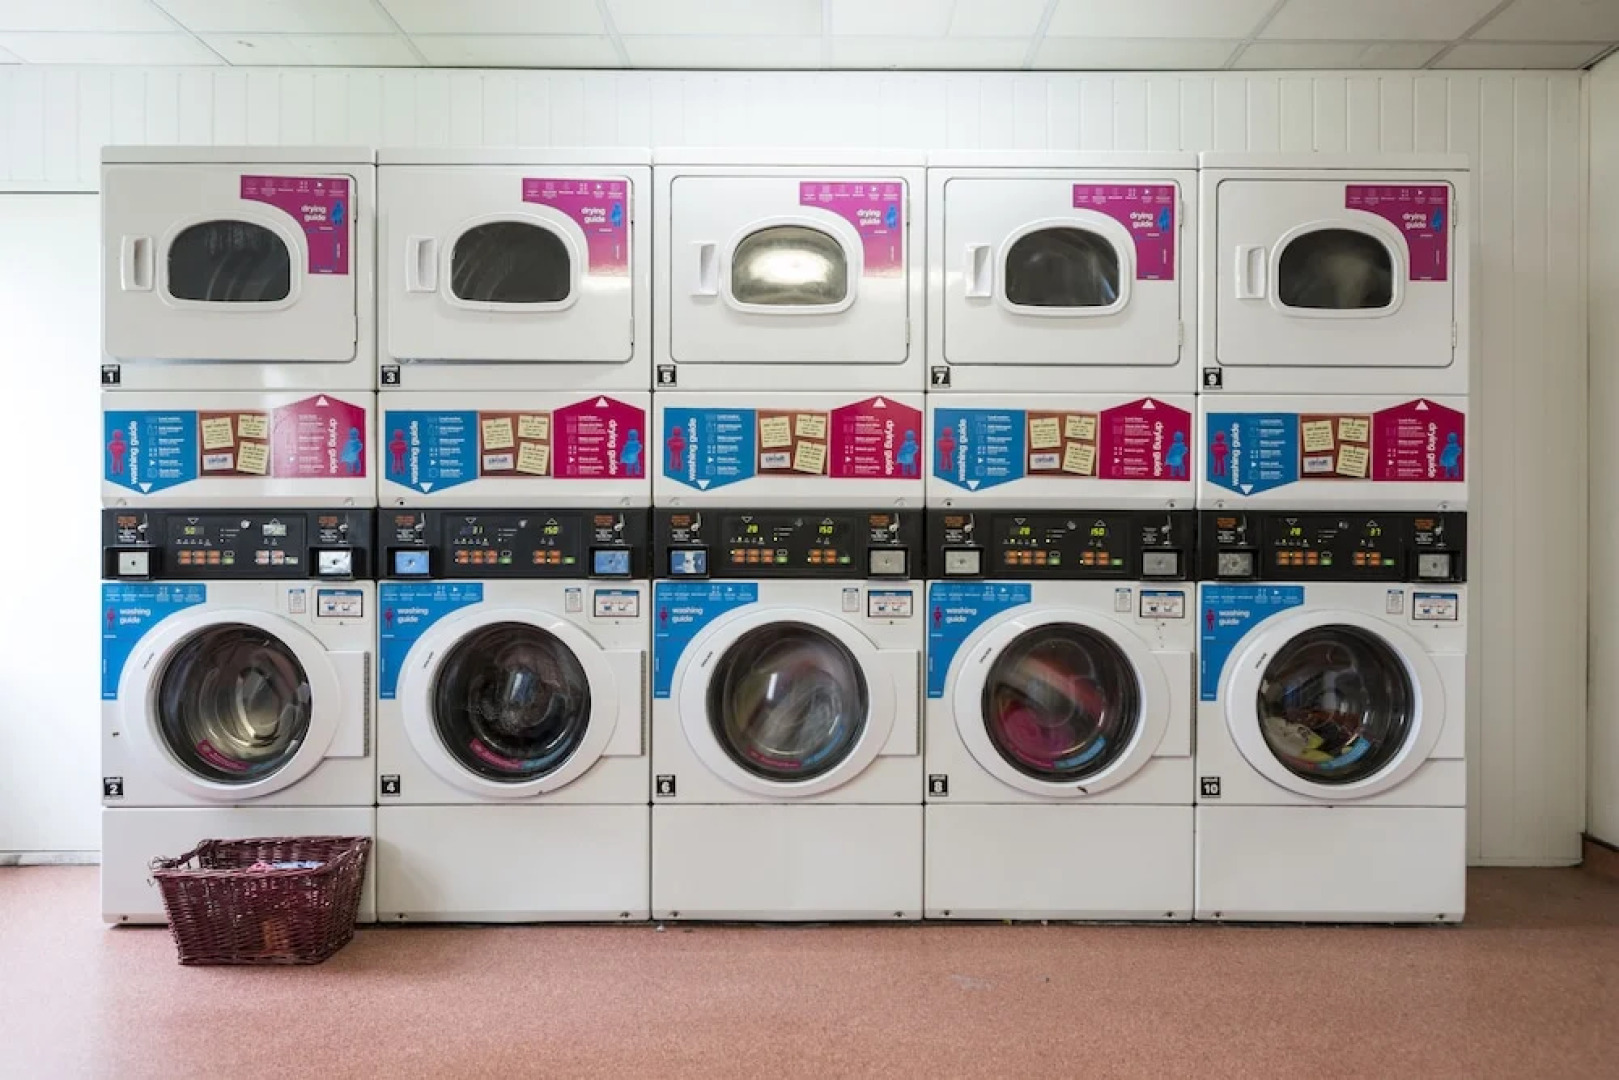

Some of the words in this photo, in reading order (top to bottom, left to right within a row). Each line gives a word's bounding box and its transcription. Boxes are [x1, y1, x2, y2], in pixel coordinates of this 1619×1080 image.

[301, 205, 327, 215] drying
[580, 207, 606, 217] drying
[856, 209, 881, 219] drying
[304, 214, 326, 223] guide
[584, 216, 606, 225] guide
[1129, 211, 1154, 221] drying
[1401, 212, 1427, 222] drying
[860, 218, 881, 227] guide
[1133, 220, 1154, 230] guide
[1405, 221, 1427, 231] guide
[107, 372, 114, 382] 1
[387, 372, 395, 383] 3
[663, 372, 671, 383] 5
[935, 373, 945, 384] 7
[128, 421, 139, 446] guide
[328, 418, 338, 448] drying
[409, 421, 420, 446] guide
[607, 419, 618, 449] drying
[688, 417, 698, 443] guide
[883, 420, 894, 450] drying
[958, 418, 969, 444] guide
[1230, 422, 1241, 448] guide
[1152, 421, 1164, 451] drying
[1426, 422, 1438, 452] drying
[128, 447, 139, 485] washing
[328, 449, 338, 474] guide
[409, 447, 420, 485] washing
[606, 450, 617, 475] guide
[688, 444, 698, 482] washing
[883, 450, 894, 475] guide
[957, 445, 968, 482] washing
[1152, 452, 1163, 477] guide
[1426, 453, 1437, 478] guide
[1230, 449, 1241, 487] washing
[120, 607, 151, 617] washing
[397, 606, 429, 616] washing
[672, 606, 703, 616] washing
[945, 606, 977, 616] washing
[1219, 609, 1250, 619] washing
[120, 616, 141, 625] guide
[397, 615, 418, 624] guide
[672, 615, 693, 624] guide
[945, 615, 967, 624] guide
[1219, 617, 1240, 626] guide
[110, 785, 118, 794] 2
[387, 782, 395, 793] 4
[1204, 784, 1219, 794] 10
